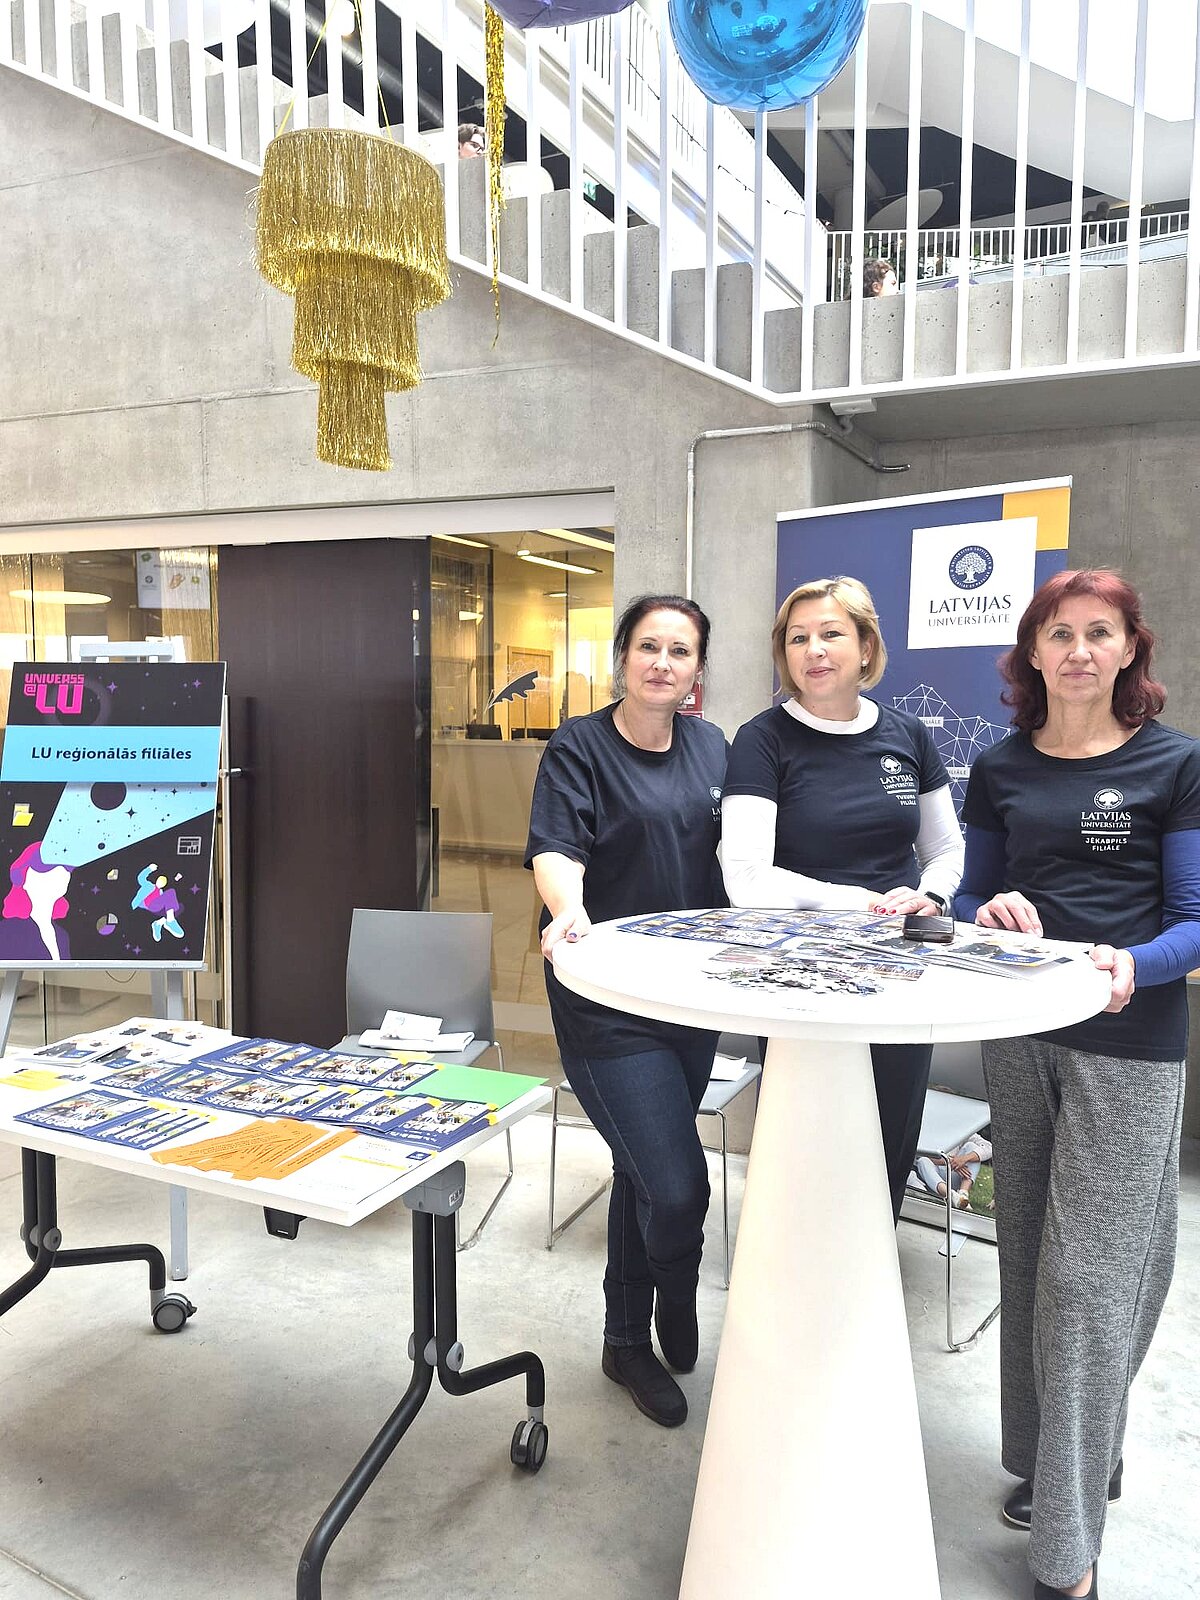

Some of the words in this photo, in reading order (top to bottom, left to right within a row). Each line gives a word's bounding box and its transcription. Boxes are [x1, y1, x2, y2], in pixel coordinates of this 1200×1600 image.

[929, 594, 1012, 613] LATVIJAS
[928, 613, 1011, 627] UNIVERSITĀTE
[24, 673, 85, 684] UNIVERSS
[31, 747, 51, 759] LU
[56, 746, 137, 762] reģionālās
[141, 747, 192, 760] filiāles
[879, 774, 914, 785] LATVIJAS
[1081, 811, 1132, 822] LATVIJAS
